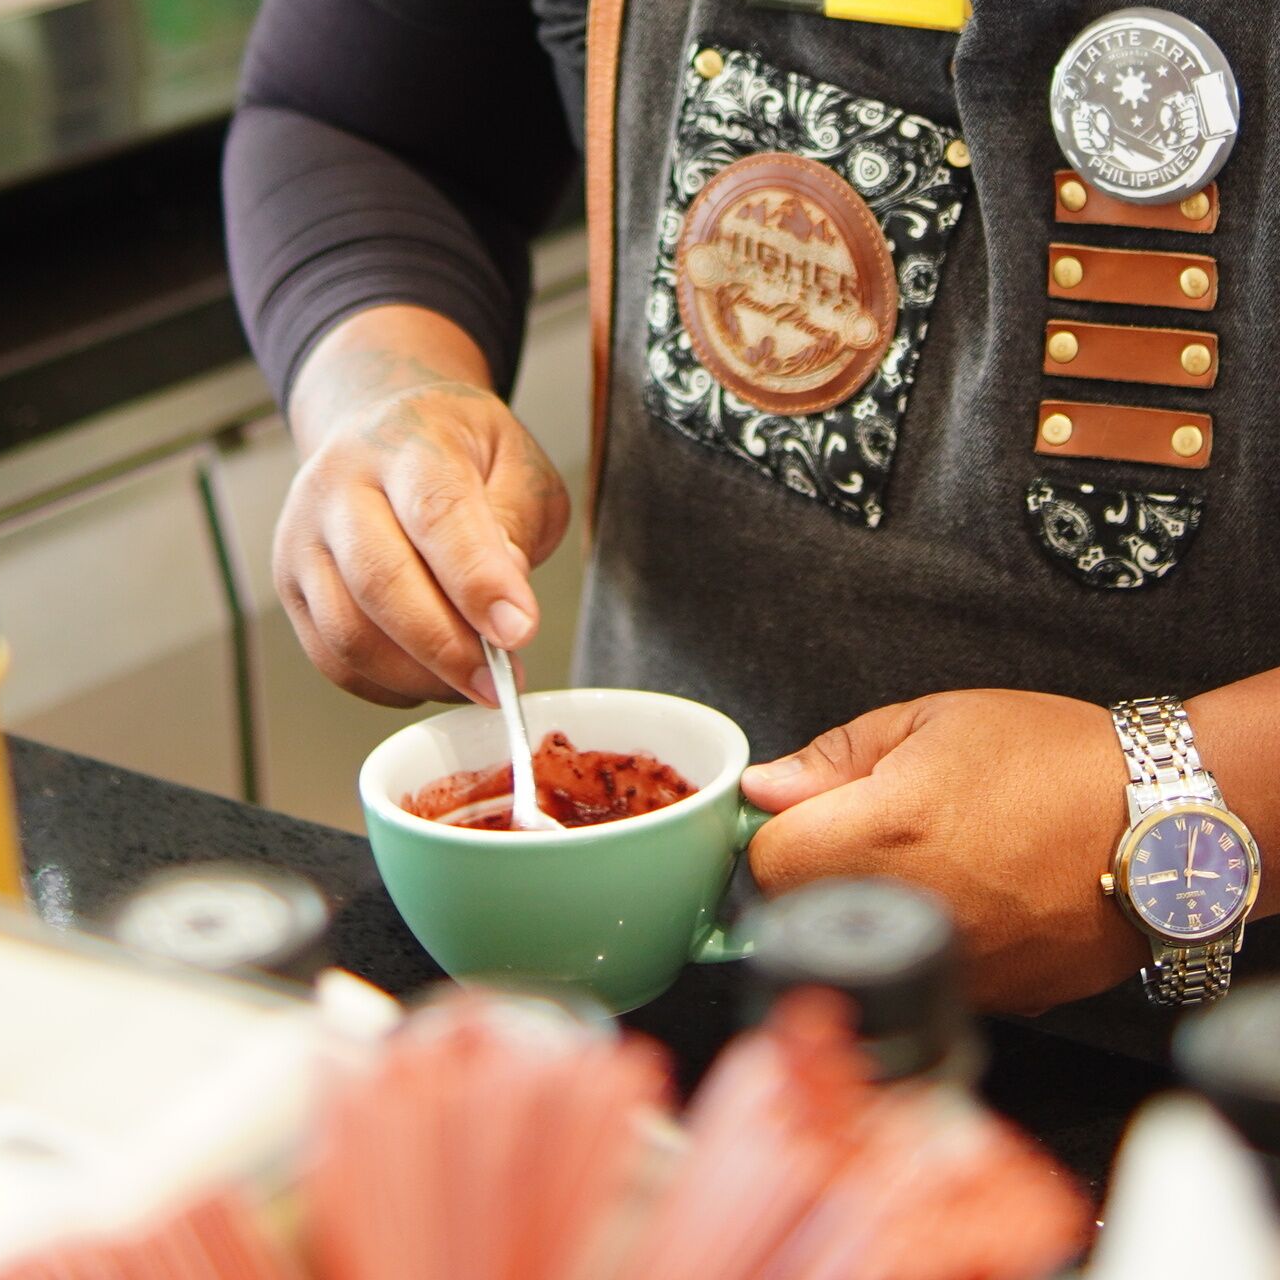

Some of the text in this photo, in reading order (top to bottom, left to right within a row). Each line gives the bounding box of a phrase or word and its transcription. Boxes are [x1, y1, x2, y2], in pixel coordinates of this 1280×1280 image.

[1076, 30, 1141, 74] LATTE
[1153, 36, 1196, 72] ART
[1088, 144, 1199, 189] PHILIPPINES
